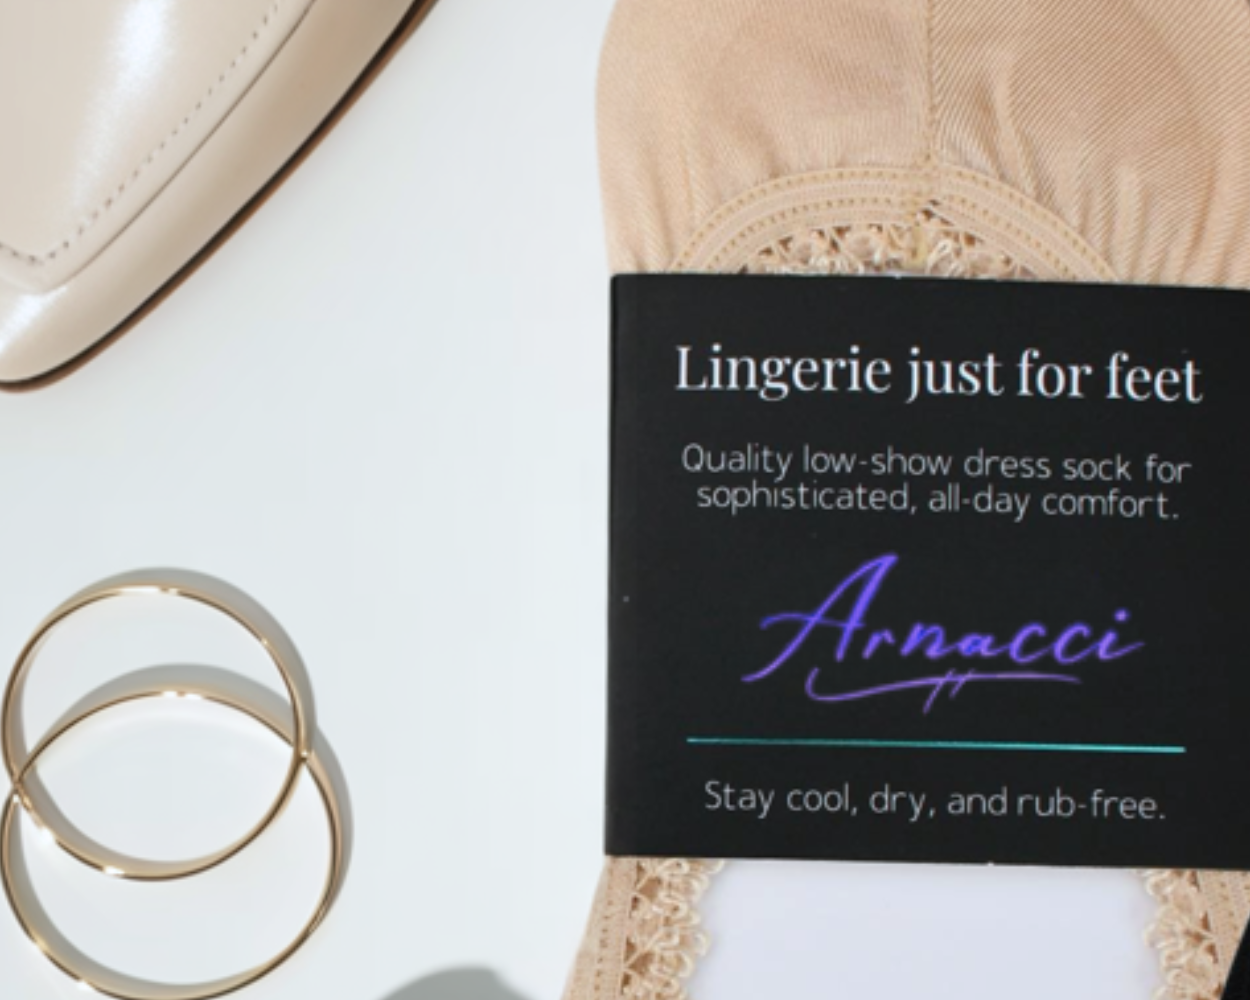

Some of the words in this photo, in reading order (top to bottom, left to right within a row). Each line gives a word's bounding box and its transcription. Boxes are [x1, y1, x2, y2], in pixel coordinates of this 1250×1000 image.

[675, 341, 892, 402] Lingerie
[905, 345, 1005, 404] just
[1016, 347, 1094, 399] for
[1105, 350, 1204, 405] feet
[681, 442, 793, 480] Quality
[803, 444, 953, 476] low-show
[963, 447, 1052, 479] dress
[1062, 453, 1132, 481] sock
[1145, 453, 1193, 484] for
[696, 481, 917, 516] sophisticated,
[928, 482, 1031, 523] all-day
[1040, 487, 1179, 519] comfort.
[740, 552, 1145, 690] Arnacci
[704, 780, 775, 820] Stay
[786, 782, 858, 816] cool,
[868, 783, 936, 823] dry,
[947, 786, 1008, 816] and
[1016, 786, 1166, 820] rub-free.
